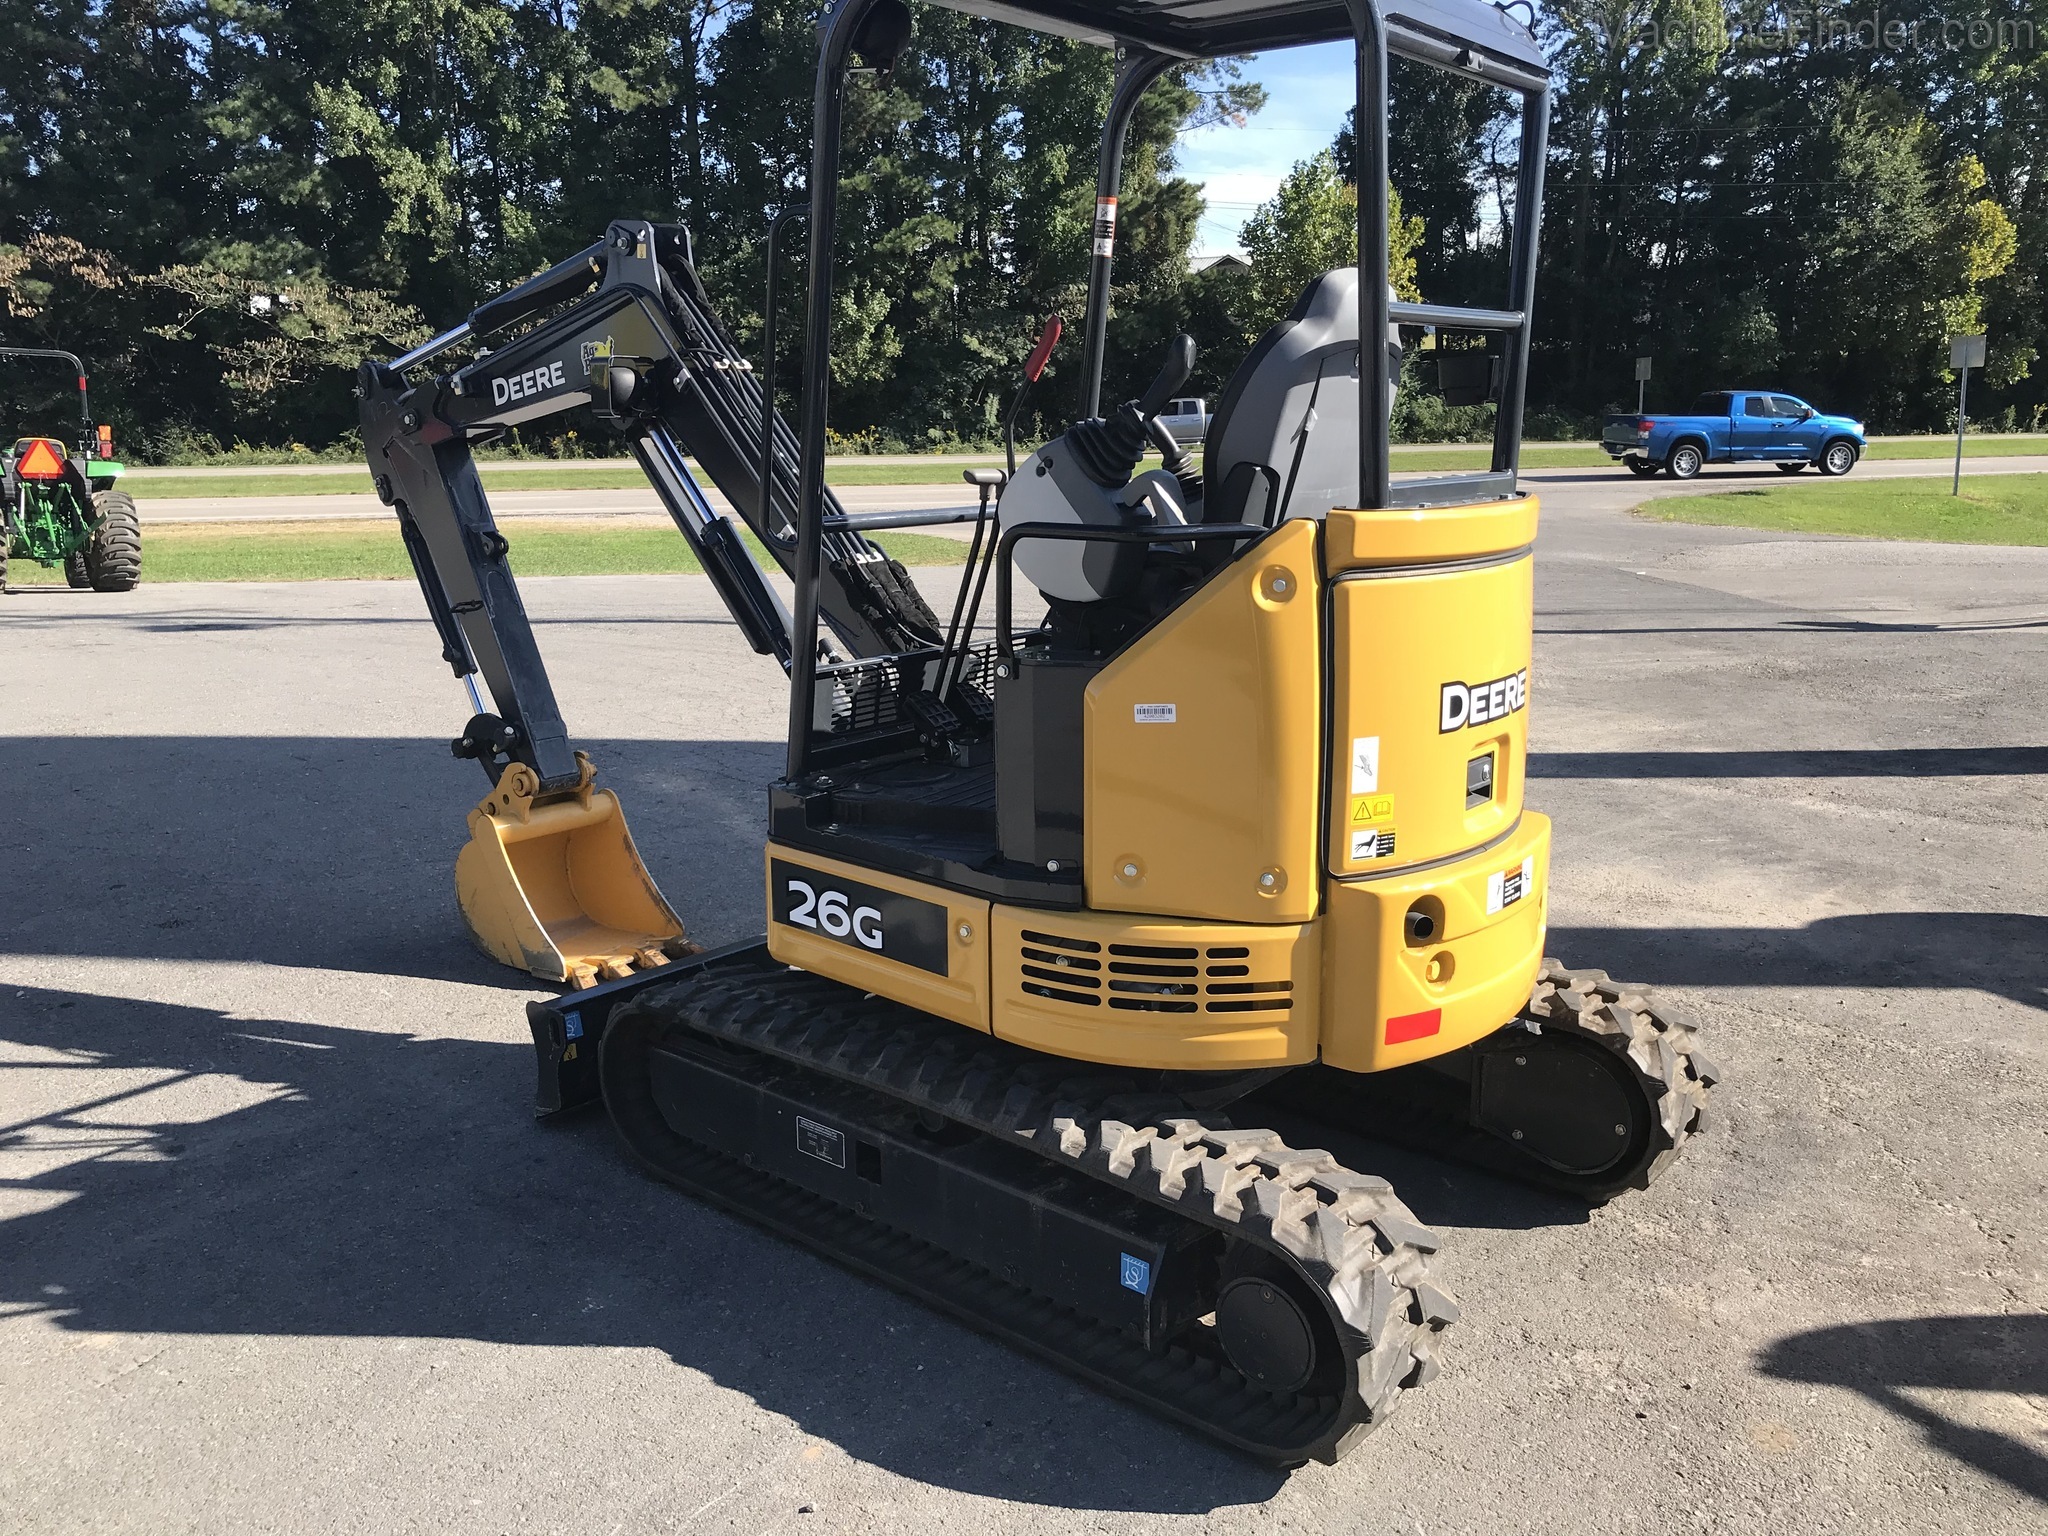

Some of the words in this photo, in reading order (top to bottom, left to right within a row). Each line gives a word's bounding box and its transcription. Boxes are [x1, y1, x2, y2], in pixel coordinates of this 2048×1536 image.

[491, 360, 566, 407] DEERE
[1440, 667, 1527, 734] DEERE
[788, 880, 883, 949] 26G
